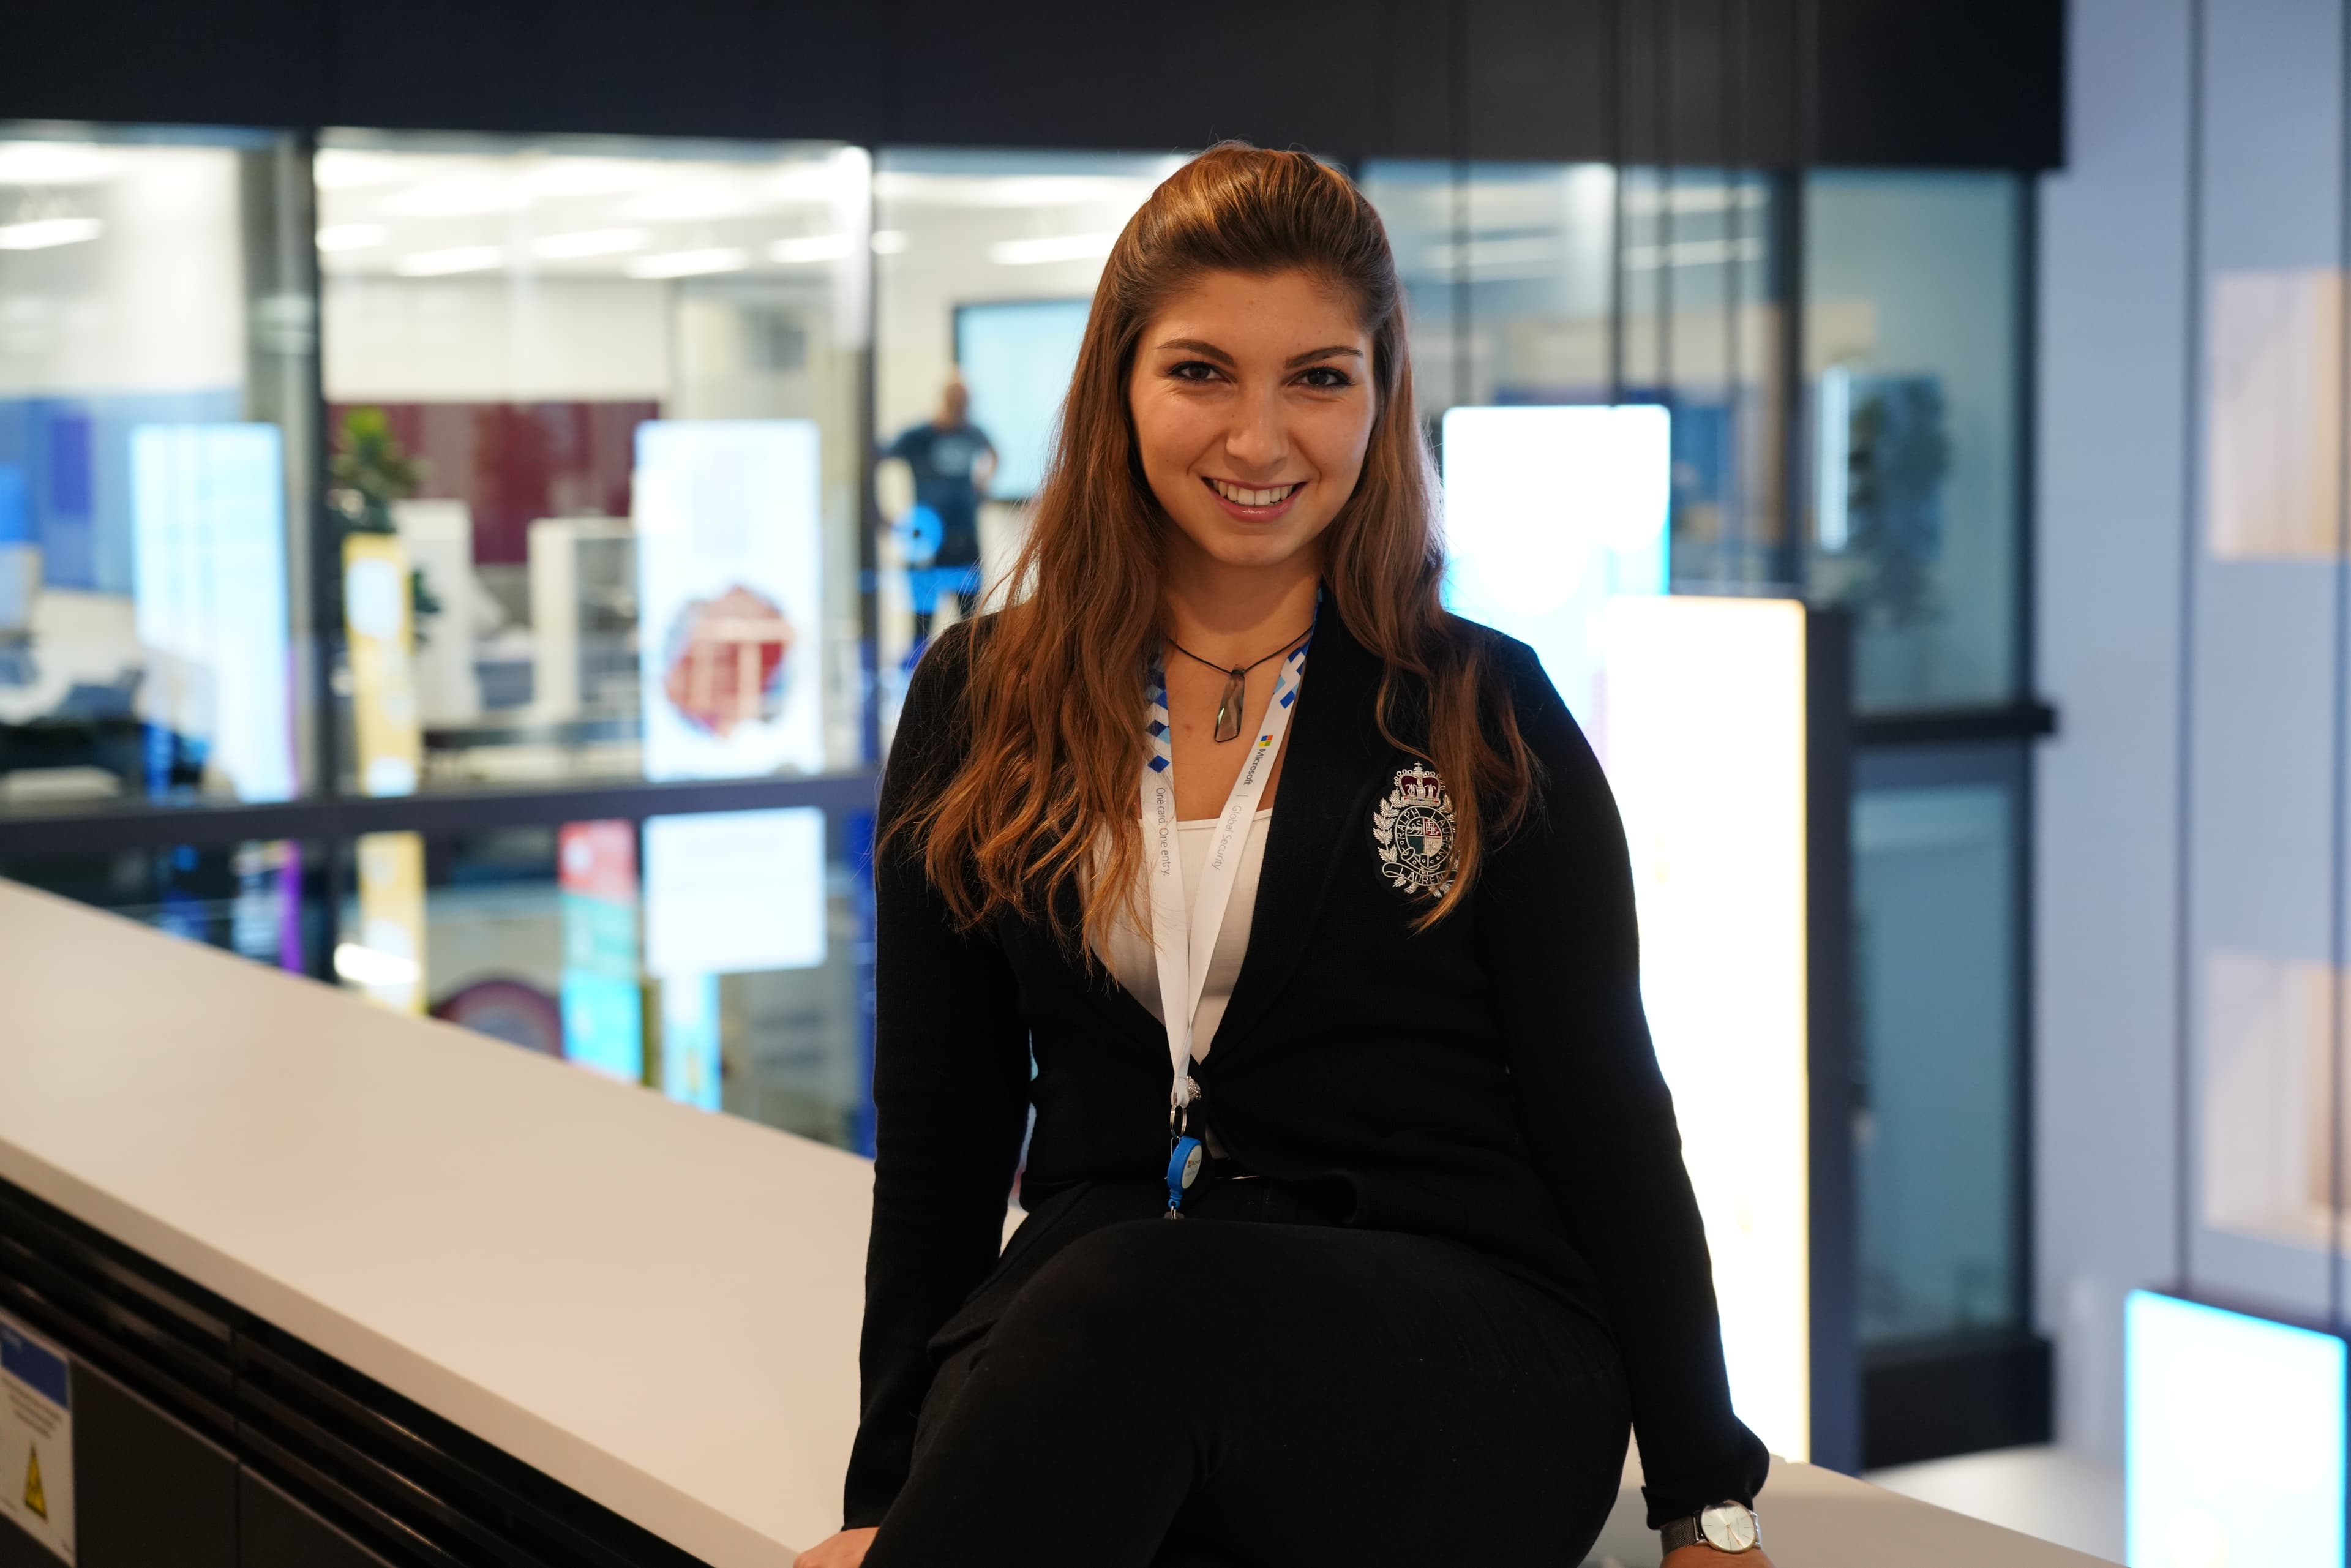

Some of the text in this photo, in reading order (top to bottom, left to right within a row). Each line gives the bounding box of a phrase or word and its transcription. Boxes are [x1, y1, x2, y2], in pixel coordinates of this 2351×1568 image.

[1156, 787, 1171, 876] One card. One entry.
[1211, 749, 1266, 871] Microsoft Global Security
[1396, 808, 1420, 839] RALPH
[1431, 811, 1452, 857] LAUREN
[1400, 866, 1445, 885] LAUREN
